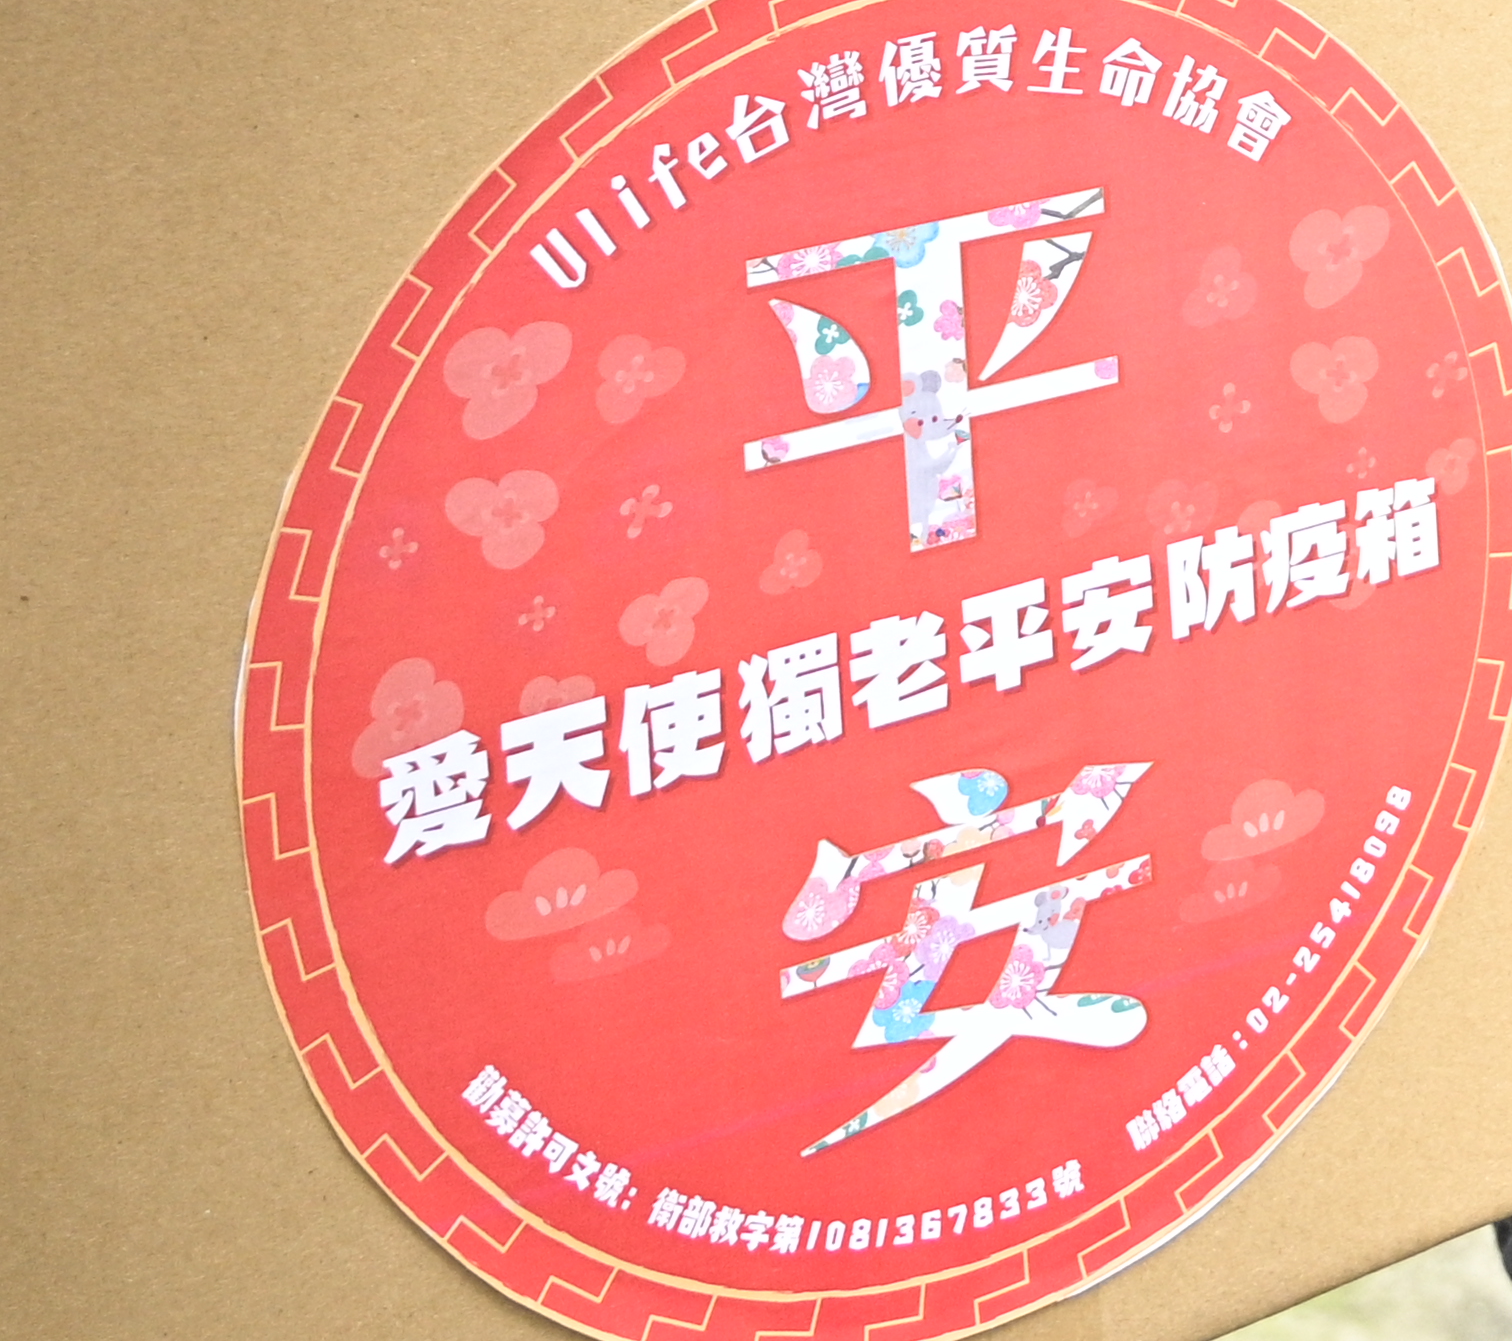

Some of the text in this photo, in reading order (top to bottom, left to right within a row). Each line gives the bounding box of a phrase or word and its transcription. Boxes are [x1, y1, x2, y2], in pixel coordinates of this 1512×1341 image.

[744, 187, 1119, 555] 平
[378, 477, 1442, 865] 愛天使獨老平安防疫箱
[781, 762, 1154, 1157] 安
